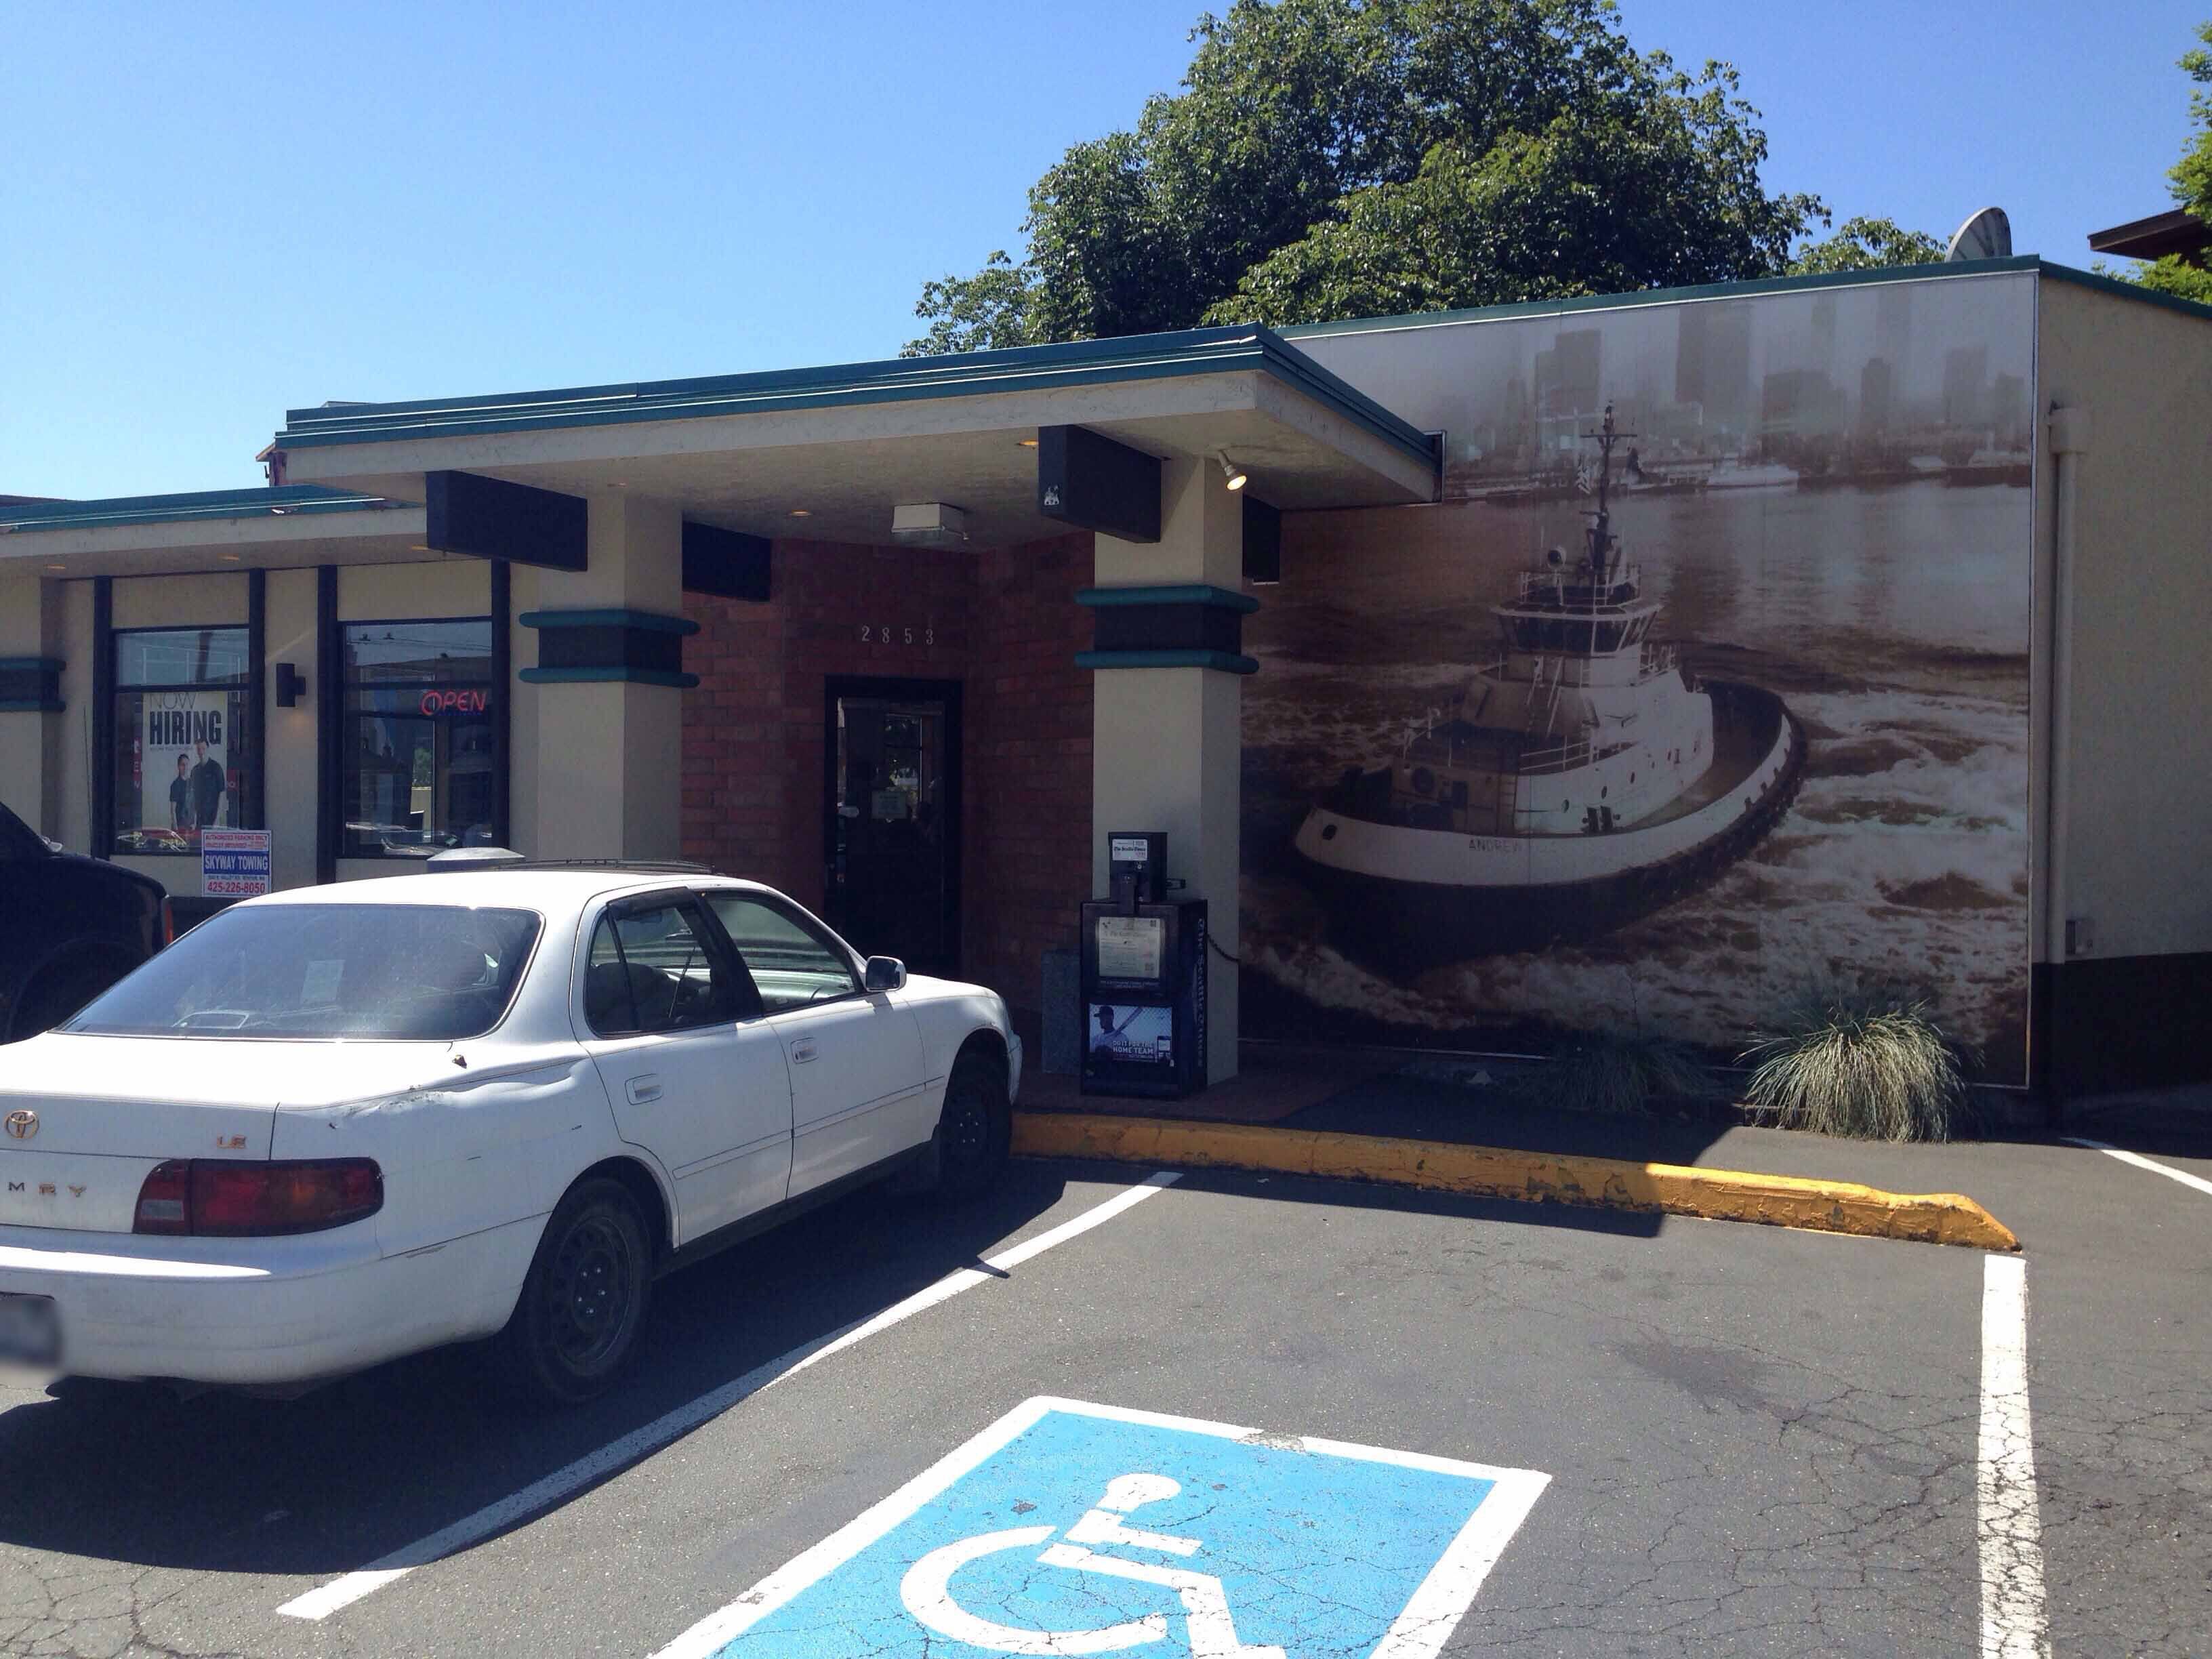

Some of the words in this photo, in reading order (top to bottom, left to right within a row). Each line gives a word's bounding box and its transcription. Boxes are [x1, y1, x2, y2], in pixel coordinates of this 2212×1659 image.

[861, 625, 933, 644] 2853
[150, 692, 196, 709] NOW
[422, 689, 487, 715] OPEN
[149, 710, 222, 745] HIRING
[205, 855, 235, 869] SKYWAY
[238, 855, 268, 870] TOWING
[207, 880, 266, 894] 425-226-8050
[1134, 1047, 1153, 1055] TEAM
[216, 1134, 247, 1149] LE
